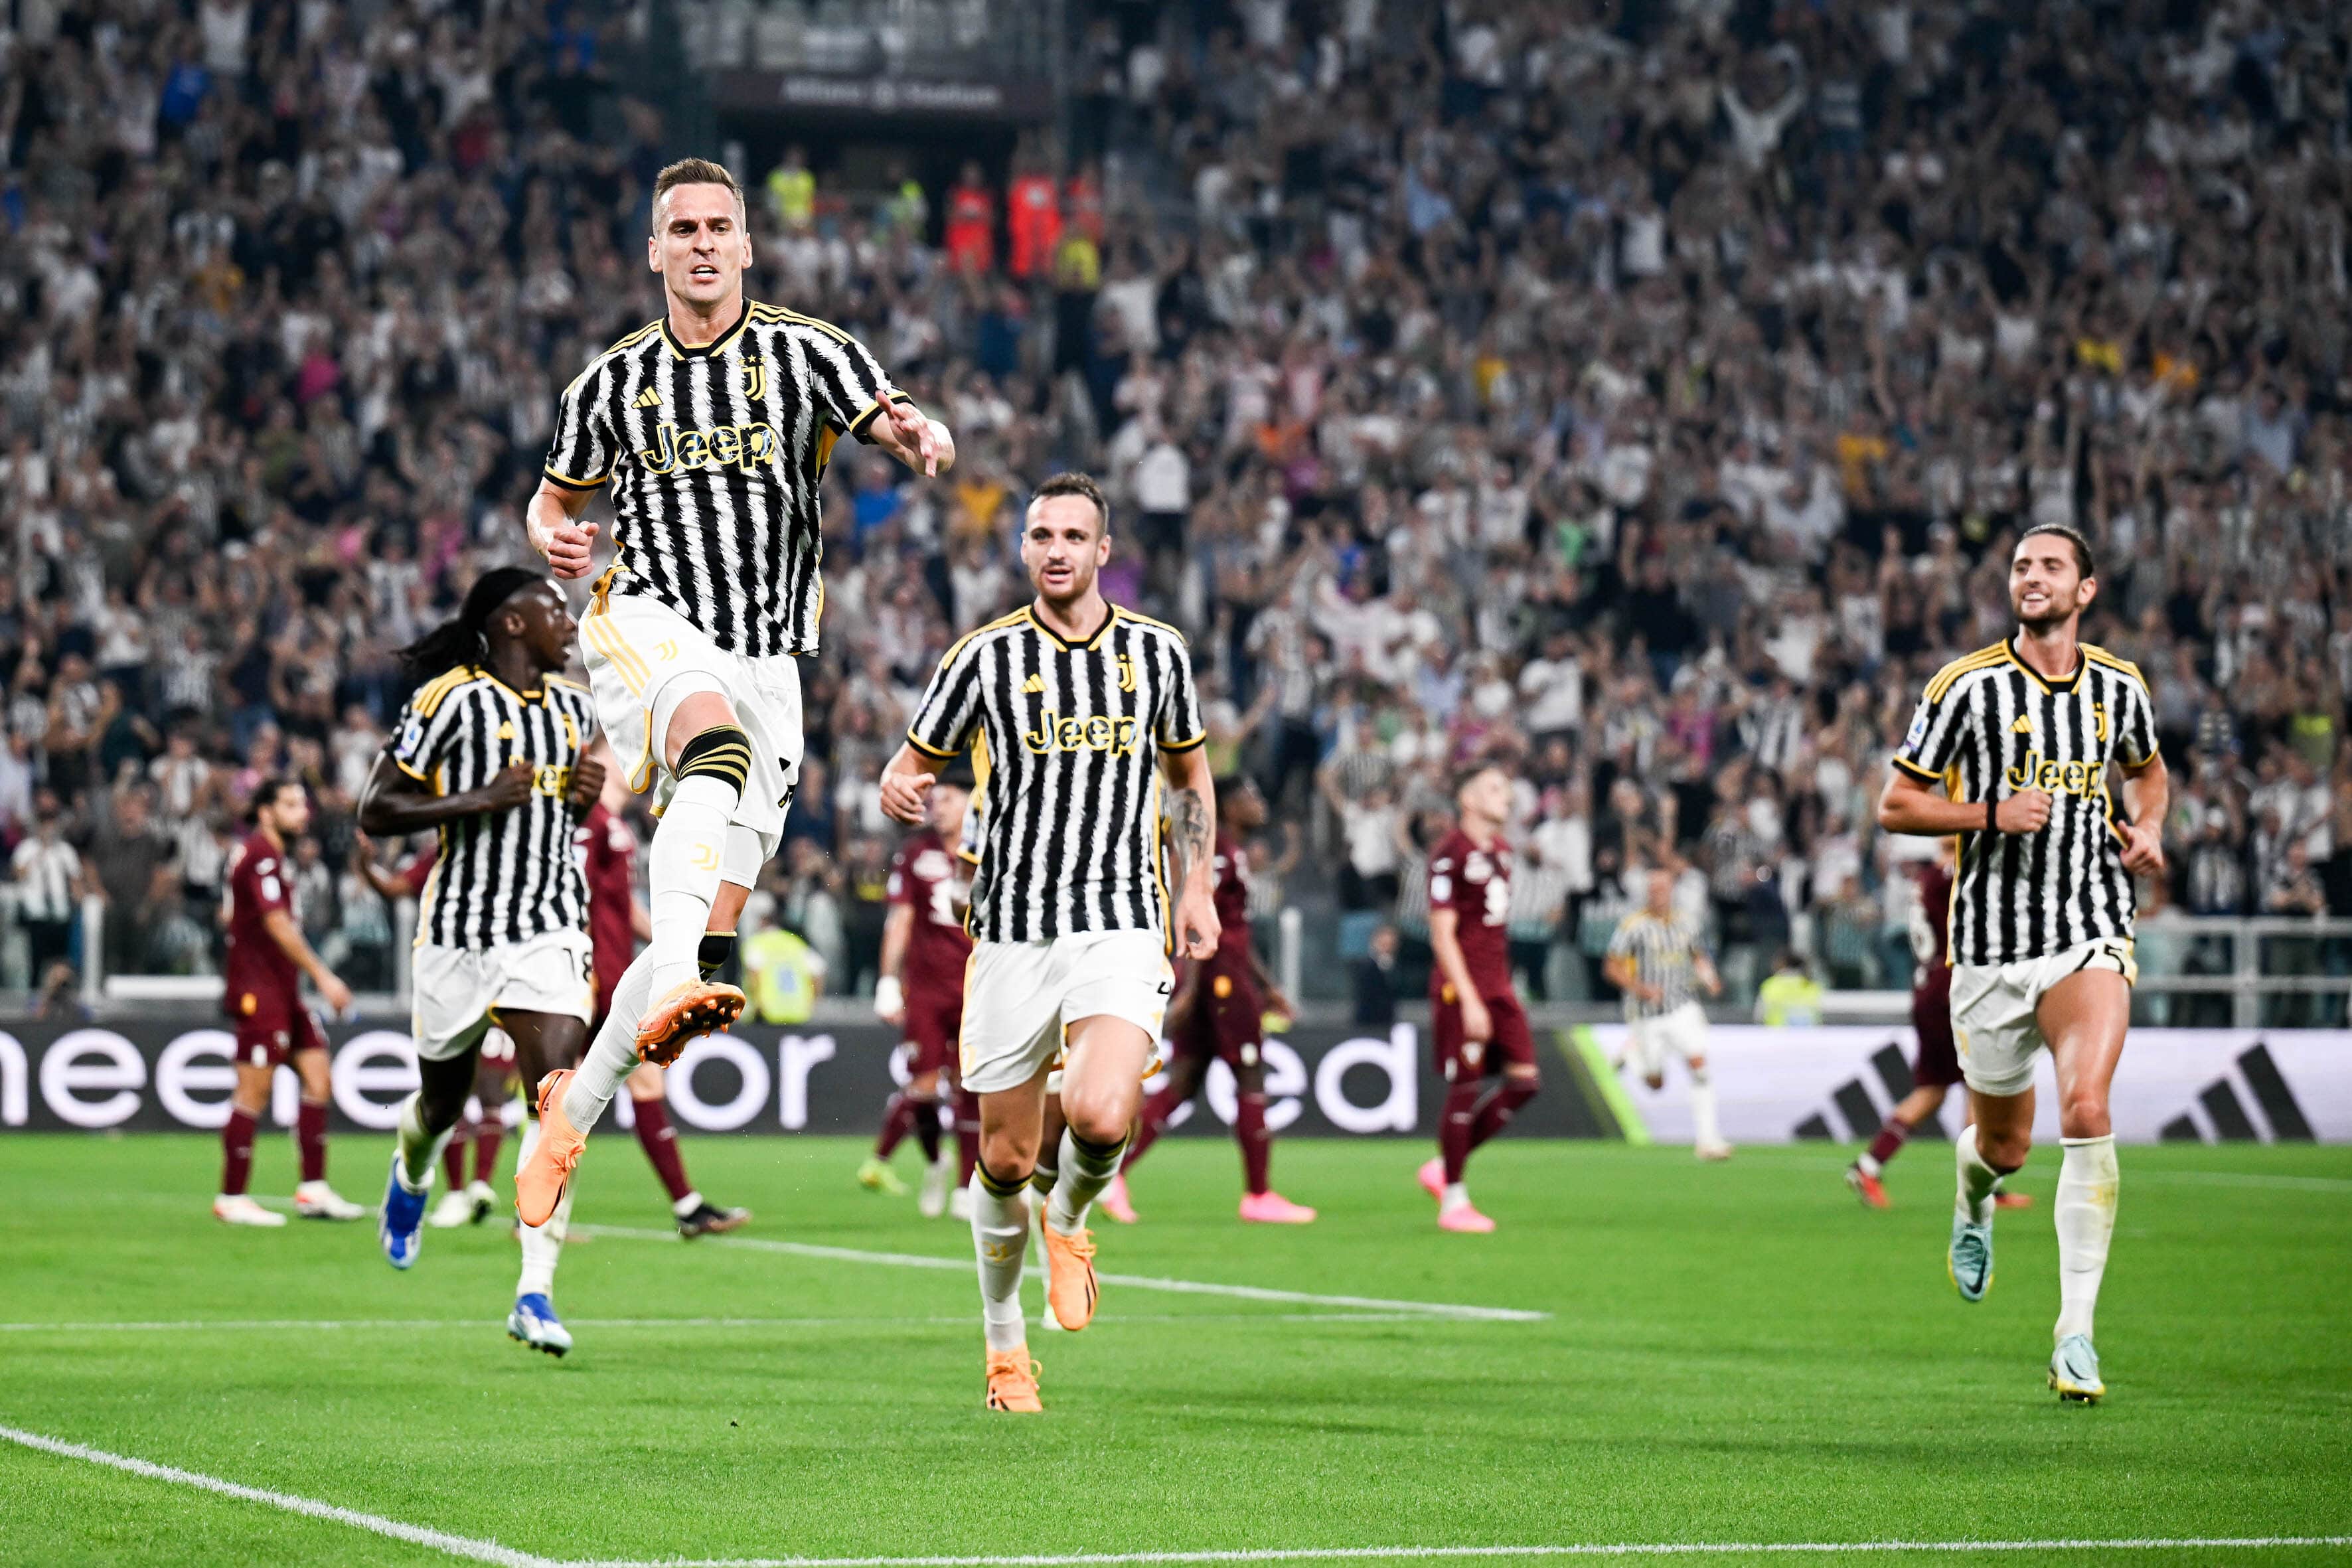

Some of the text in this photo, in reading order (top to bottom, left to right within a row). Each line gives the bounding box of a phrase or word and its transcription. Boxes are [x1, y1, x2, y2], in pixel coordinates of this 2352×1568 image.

[642, 422, 776, 474] Jeep
[1024, 710, 1140, 757] Jeep
[2007, 749, 2104, 801] Jeep
[615, 1032, 836, 1131] or
